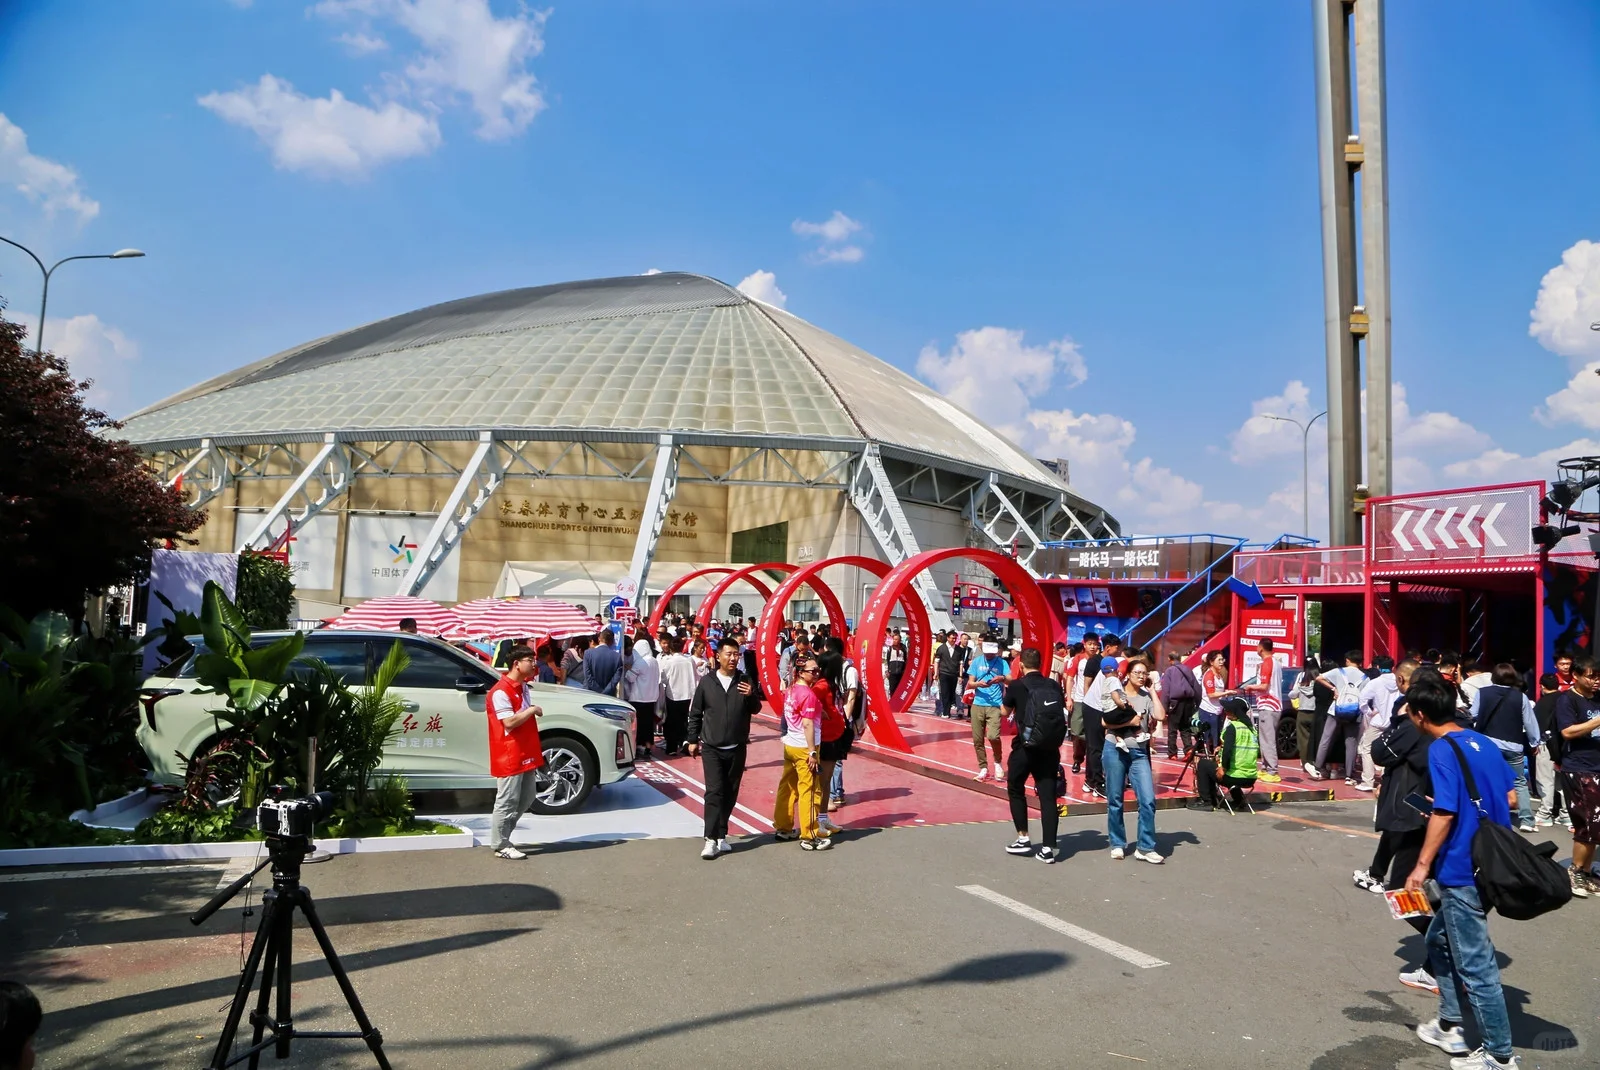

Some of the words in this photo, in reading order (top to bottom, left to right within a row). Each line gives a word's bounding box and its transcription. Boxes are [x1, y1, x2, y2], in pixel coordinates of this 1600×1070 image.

[499, 499, 699, 527] 长春体育中心五环育馆
[551, 522, 582, 532] SPORTS
[614, 526, 638, 536] WUHU
[1069, 551, 1110, 568] 一路长马
[1112, 549, 1160, 567] 一路长红
[969, 600, 997, 608] 礼品兑换
[402, 713, 444, 734] 红旗
[396, 737, 447, 749] 指定用车
